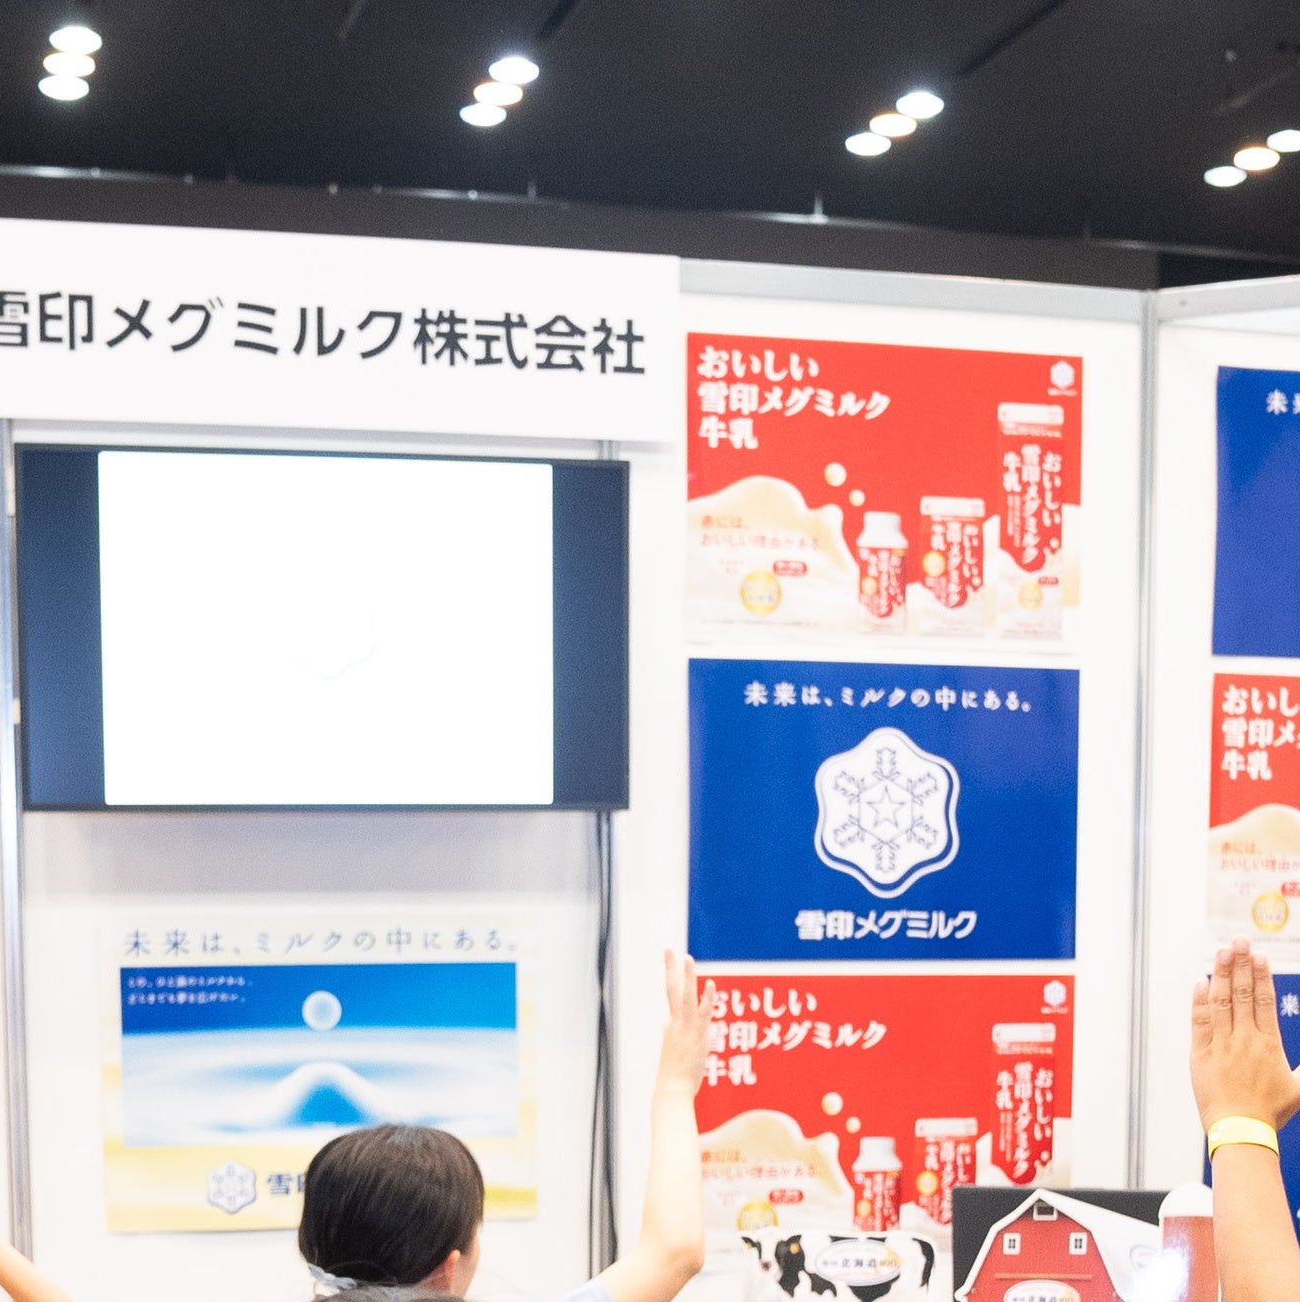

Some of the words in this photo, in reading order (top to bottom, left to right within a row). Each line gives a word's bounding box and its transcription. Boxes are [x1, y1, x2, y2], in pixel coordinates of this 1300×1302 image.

[697, 345, 819, 382] おいしい
[697, 381, 891, 420] 雪印メグミルク
[698, 415, 759, 450] 牛乳
[743, 680, 1032, 714] 未来は、ミルクの中にある。
[1221, 749, 1273, 780] 牛乳
[794, 908, 978, 941] 雪印メグミルク
[124, 928, 518, 957] 未来は、ミルクの中にある。
[709, 987, 818, 1018] おいしい
[707, 1020, 888, 1051] 雪印メグミルク
[702, 1053, 757, 1086] 牛乳
